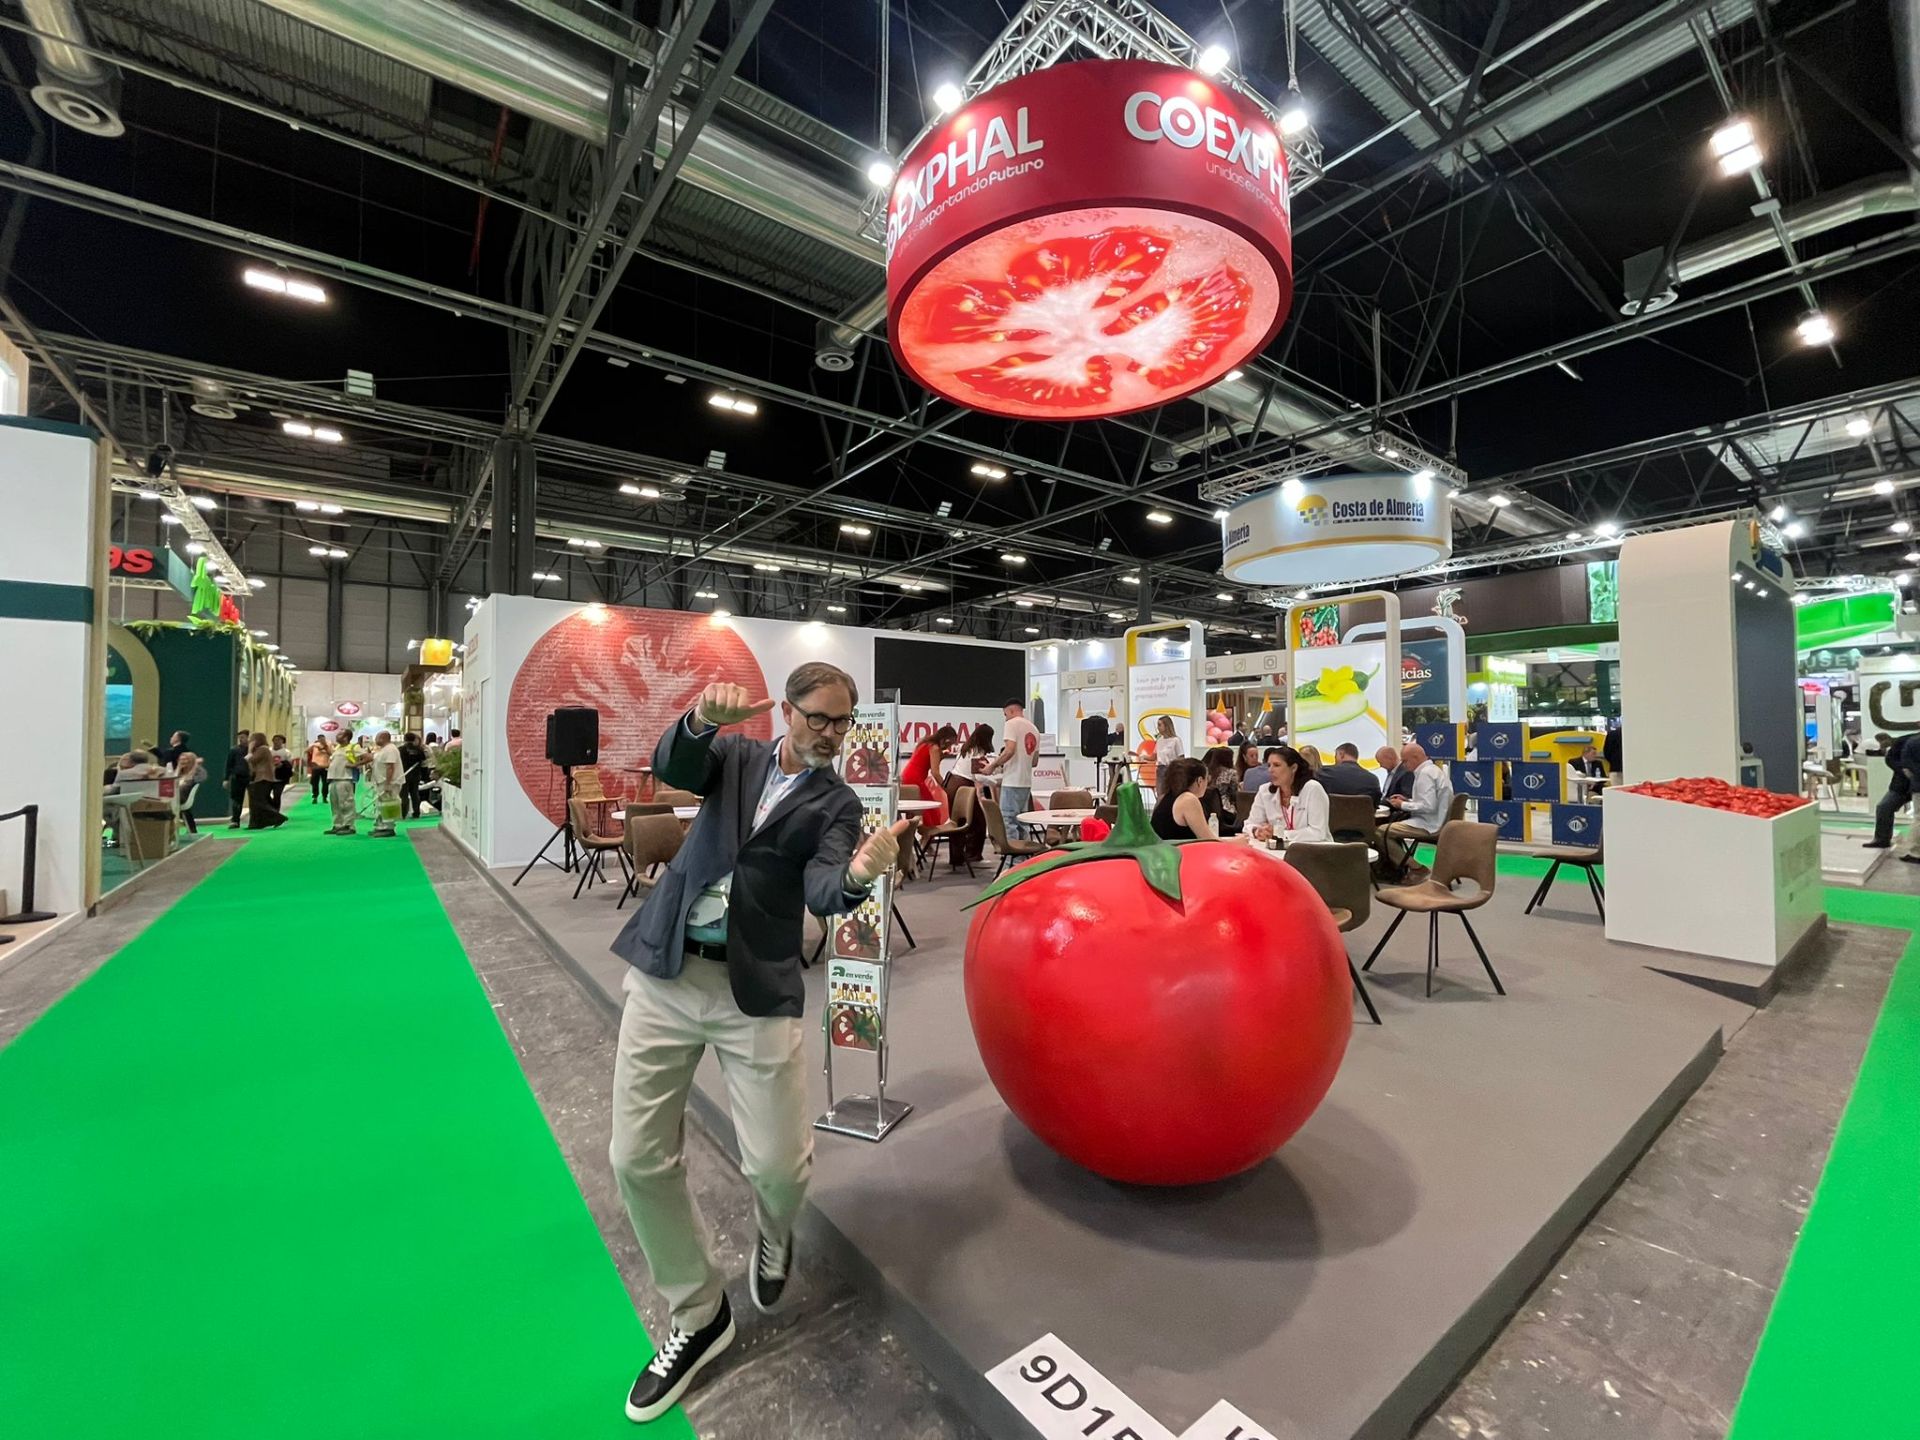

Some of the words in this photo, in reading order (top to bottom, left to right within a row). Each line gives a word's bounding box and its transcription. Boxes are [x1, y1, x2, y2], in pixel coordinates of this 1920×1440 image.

[887, 106, 1044, 262] OEXPHAL
[1332, 501, 1368, 518] Costa
[1369, 499, 1384, 516] de
[1385, 498, 1425, 517] Almería
[1401, 667, 1432, 680] icias
[854, 973, 874, 981] verde
